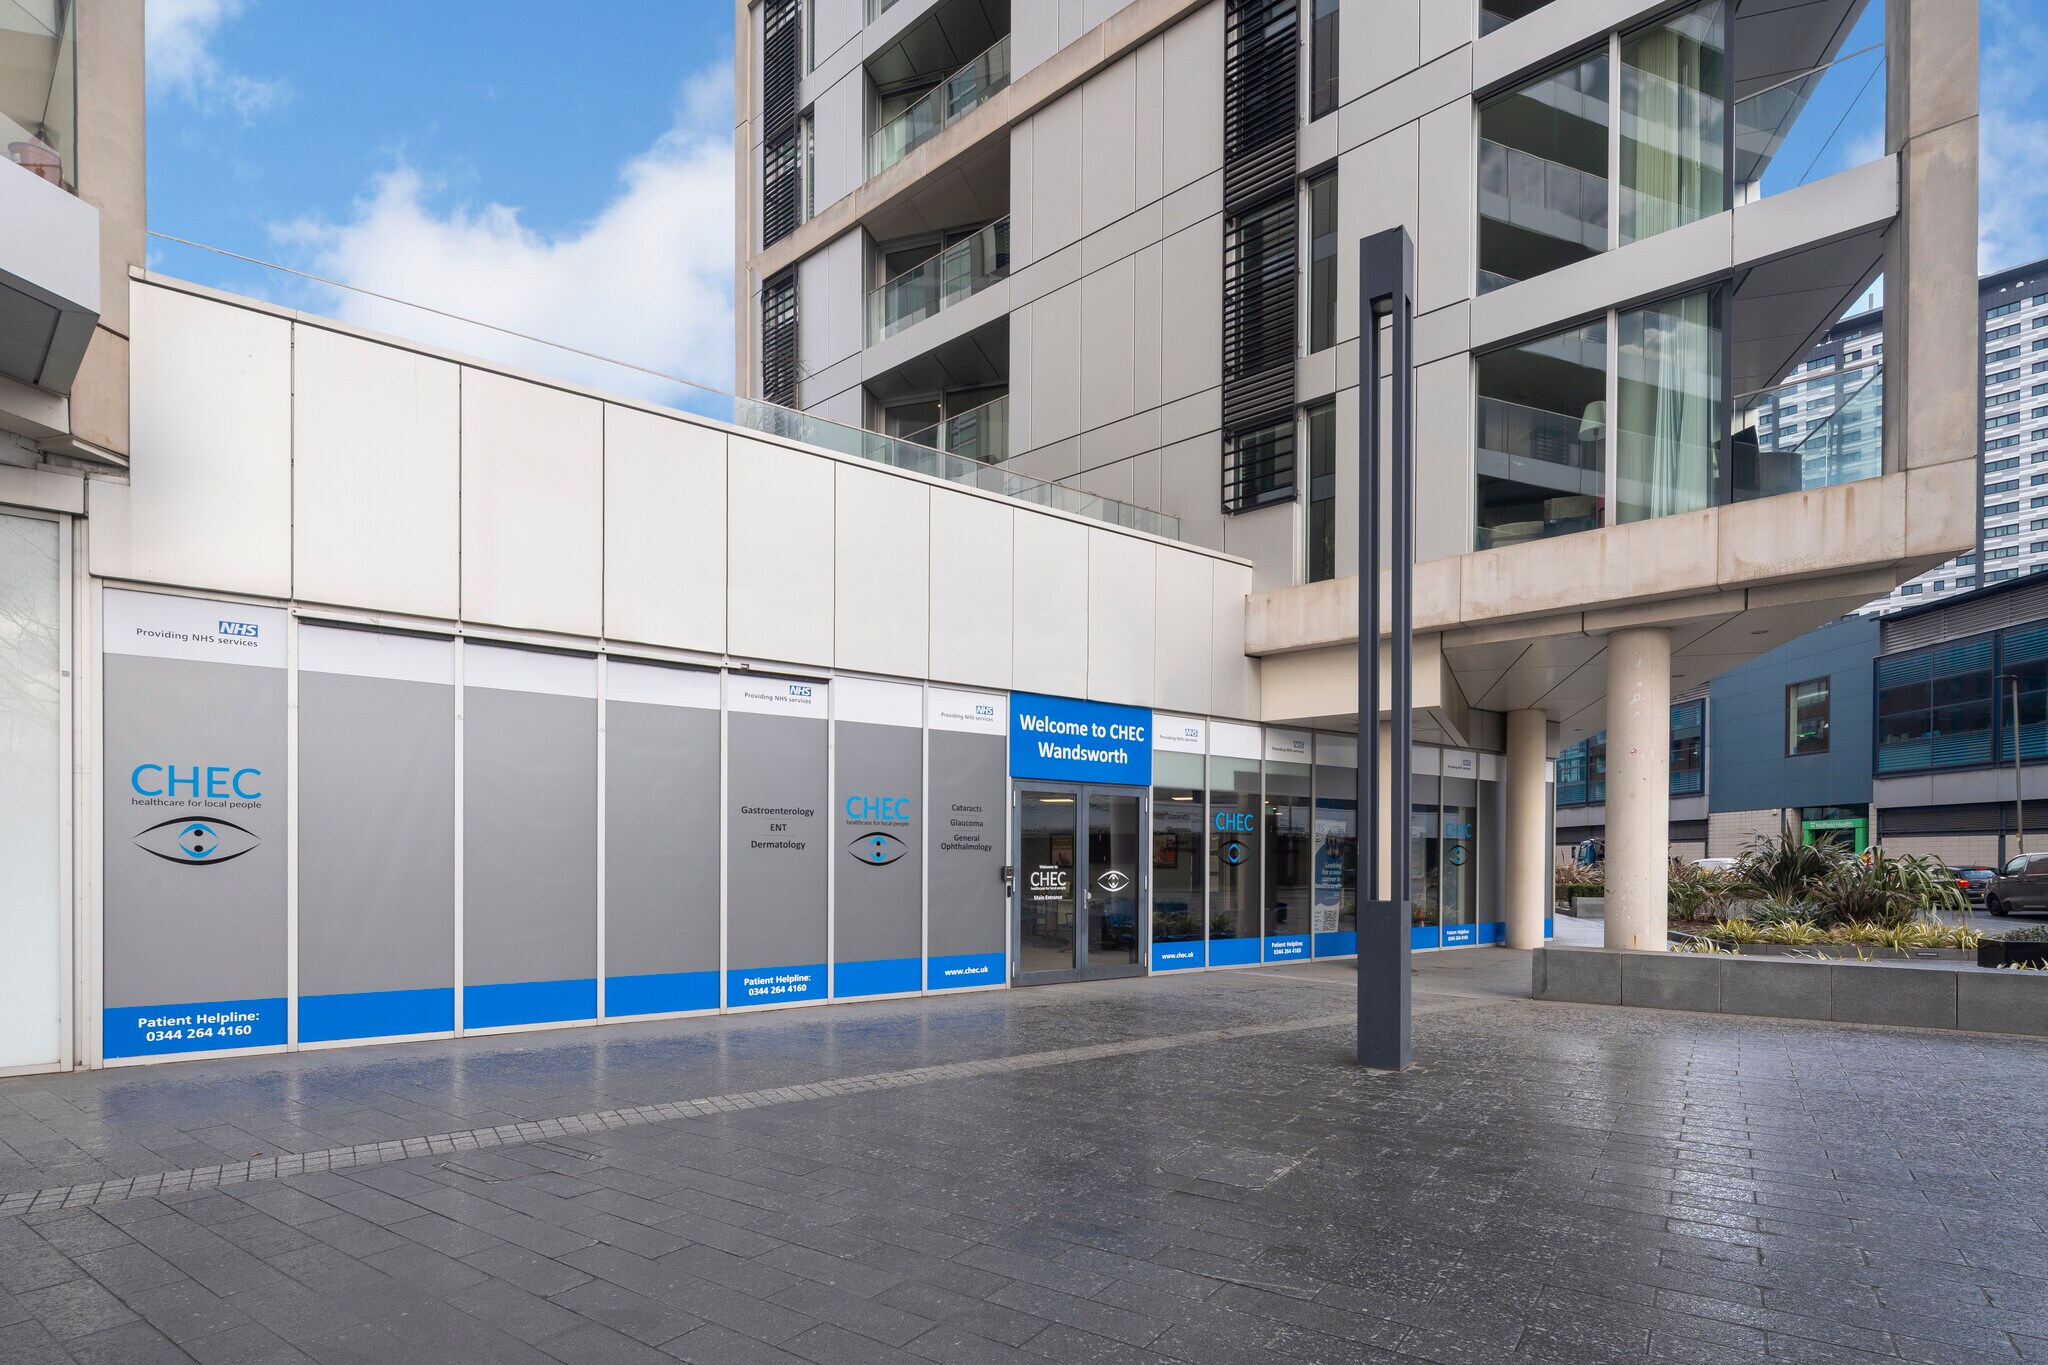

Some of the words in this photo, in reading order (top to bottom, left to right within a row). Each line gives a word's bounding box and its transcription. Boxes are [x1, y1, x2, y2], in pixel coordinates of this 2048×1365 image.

[220, 622, 257, 636] NHS
[136, 628, 189, 642] Providing
[192, 634, 215, 643] NHS
[218, 637, 258, 647] services
[790, 685, 811, 696] NHS
[744, 692, 774, 701] Providing
[976, 705, 993, 715] NHS
[941, 712, 964, 721] Providing
[1019, 713, 1088, 736] Welcome
[1091, 722, 1107, 738] to
[1109, 724, 1145, 742] CHEC
[1037, 741, 1128, 764] Wandsworth
[131, 763, 262, 799] CHEC
[131, 797, 185, 807] healthcare
[188, 798, 202, 807] for
[204, 800, 227, 808] local
[229, 801, 262, 810] people
[846, 795, 910, 820] CHEC
[951, 803, 983, 812] Cataracts
[741, 806, 815, 817] Gastroenterology
[950, 819, 984, 827] Glaucoma
[1215, 812, 1254, 831] CHEC
[1815, 821, 1835, 829] Nuffield
[770, 823, 787, 832] ENT
[953, 834, 980, 842] General
[750, 840, 806, 850] Dermatology
[940, 842, 993, 852] Ophthalmology
[1030, 871, 1067, 887] CHEC
[1161, 951, 1194, 960] www.chec.uk
[944, 965, 989, 976] www.chec.uk
[743, 977, 774, 986] Patient
[775, 974, 811, 984] Helpline:
[748, 987, 769, 996] 0344
[770, 985, 785, 994] 264
[787, 984, 807, 993] 4160
[138, 1015, 192, 1029] Patient
[196, 1011, 260, 1025] Helpline:
[146, 1029, 183, 1042] 0344
[187, 1027, 214, 1039] 264
[217, 1025, 252, 1037] 4160
